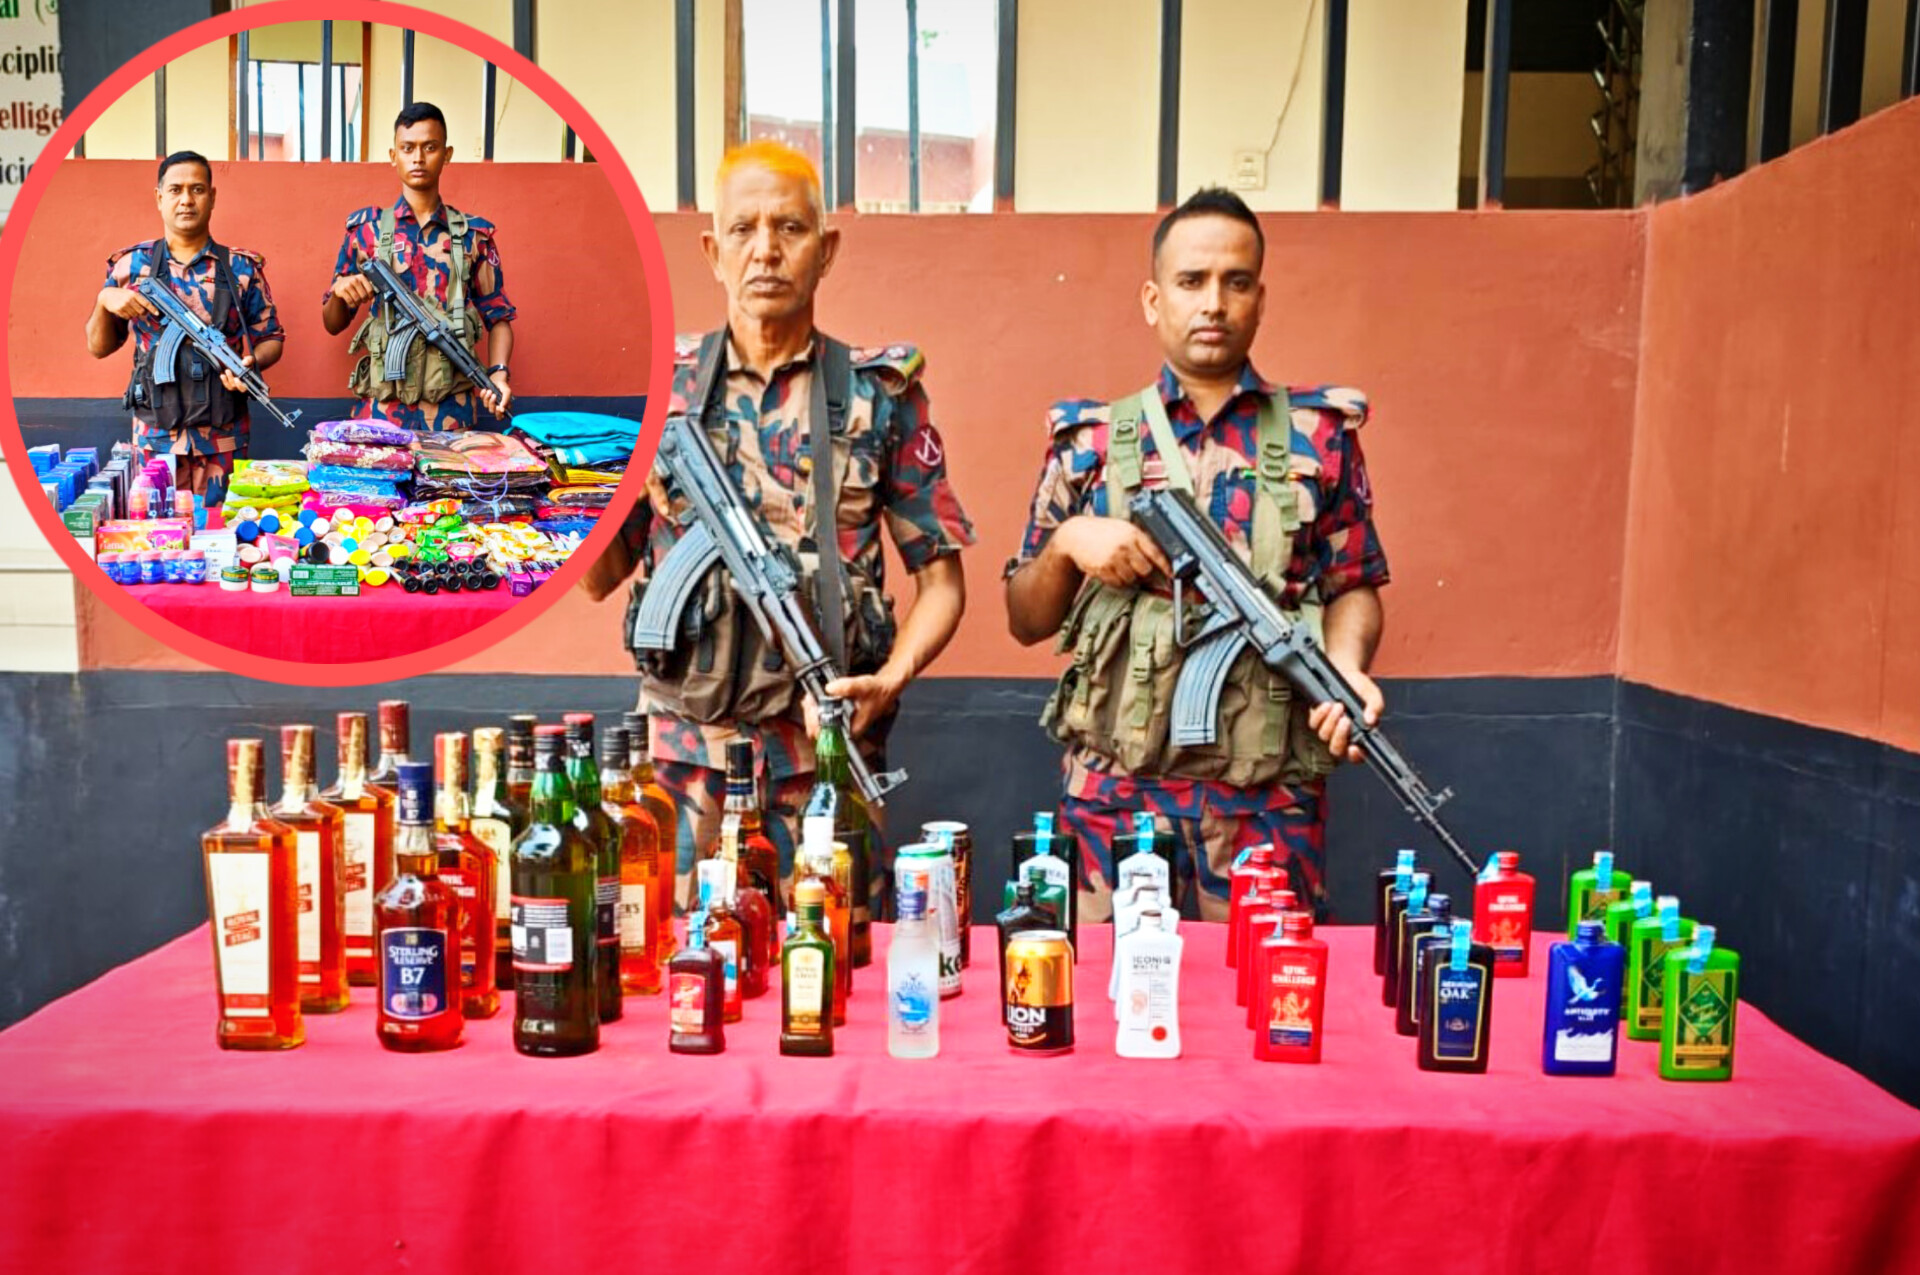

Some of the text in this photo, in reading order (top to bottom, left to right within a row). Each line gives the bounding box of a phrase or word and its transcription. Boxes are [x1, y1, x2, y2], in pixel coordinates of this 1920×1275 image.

[0, 44, 61, 80] cipli
[401, 966, 426, 985] B7
[1440, 988, 1470, 1000] OAK
